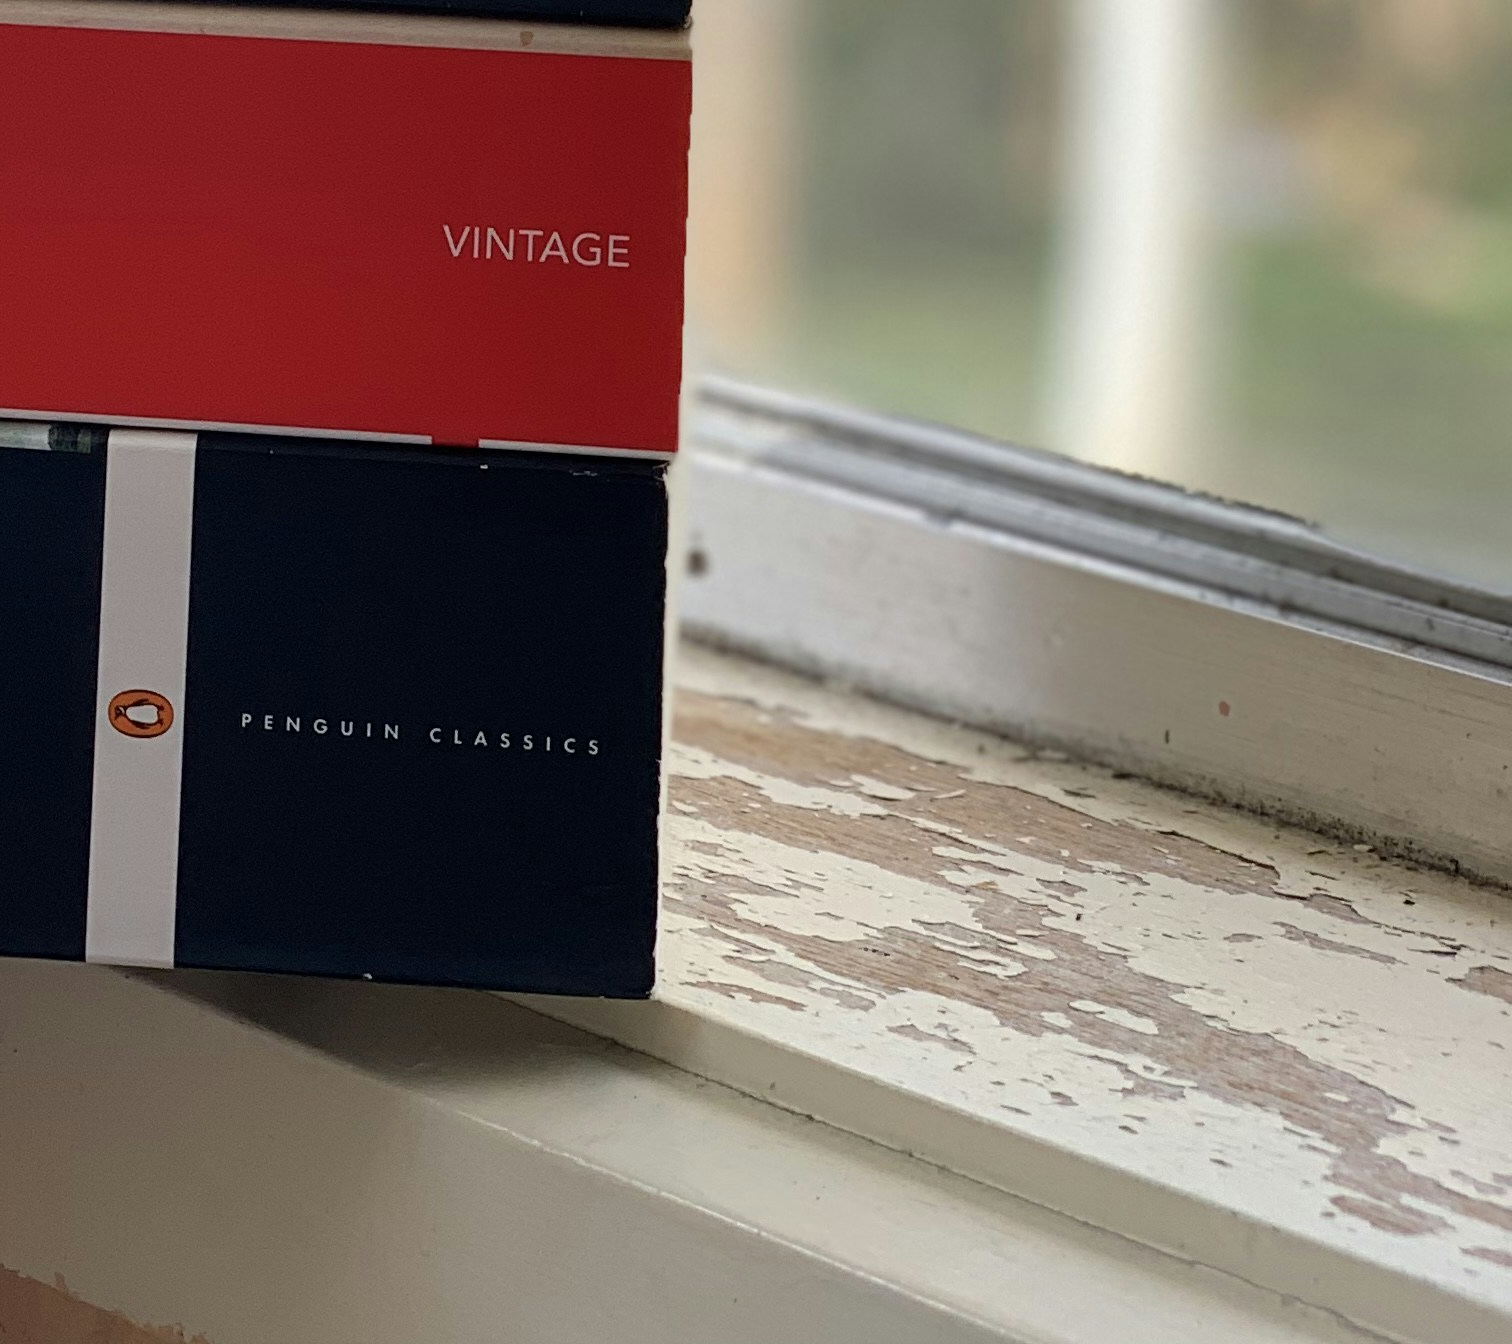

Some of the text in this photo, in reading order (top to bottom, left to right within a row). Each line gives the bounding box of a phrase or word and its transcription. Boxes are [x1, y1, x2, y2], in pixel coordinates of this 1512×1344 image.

[442, 224, 630, 268] VINTAGE
[241, 713, 599, 755] PENGUIN CLASSICS
